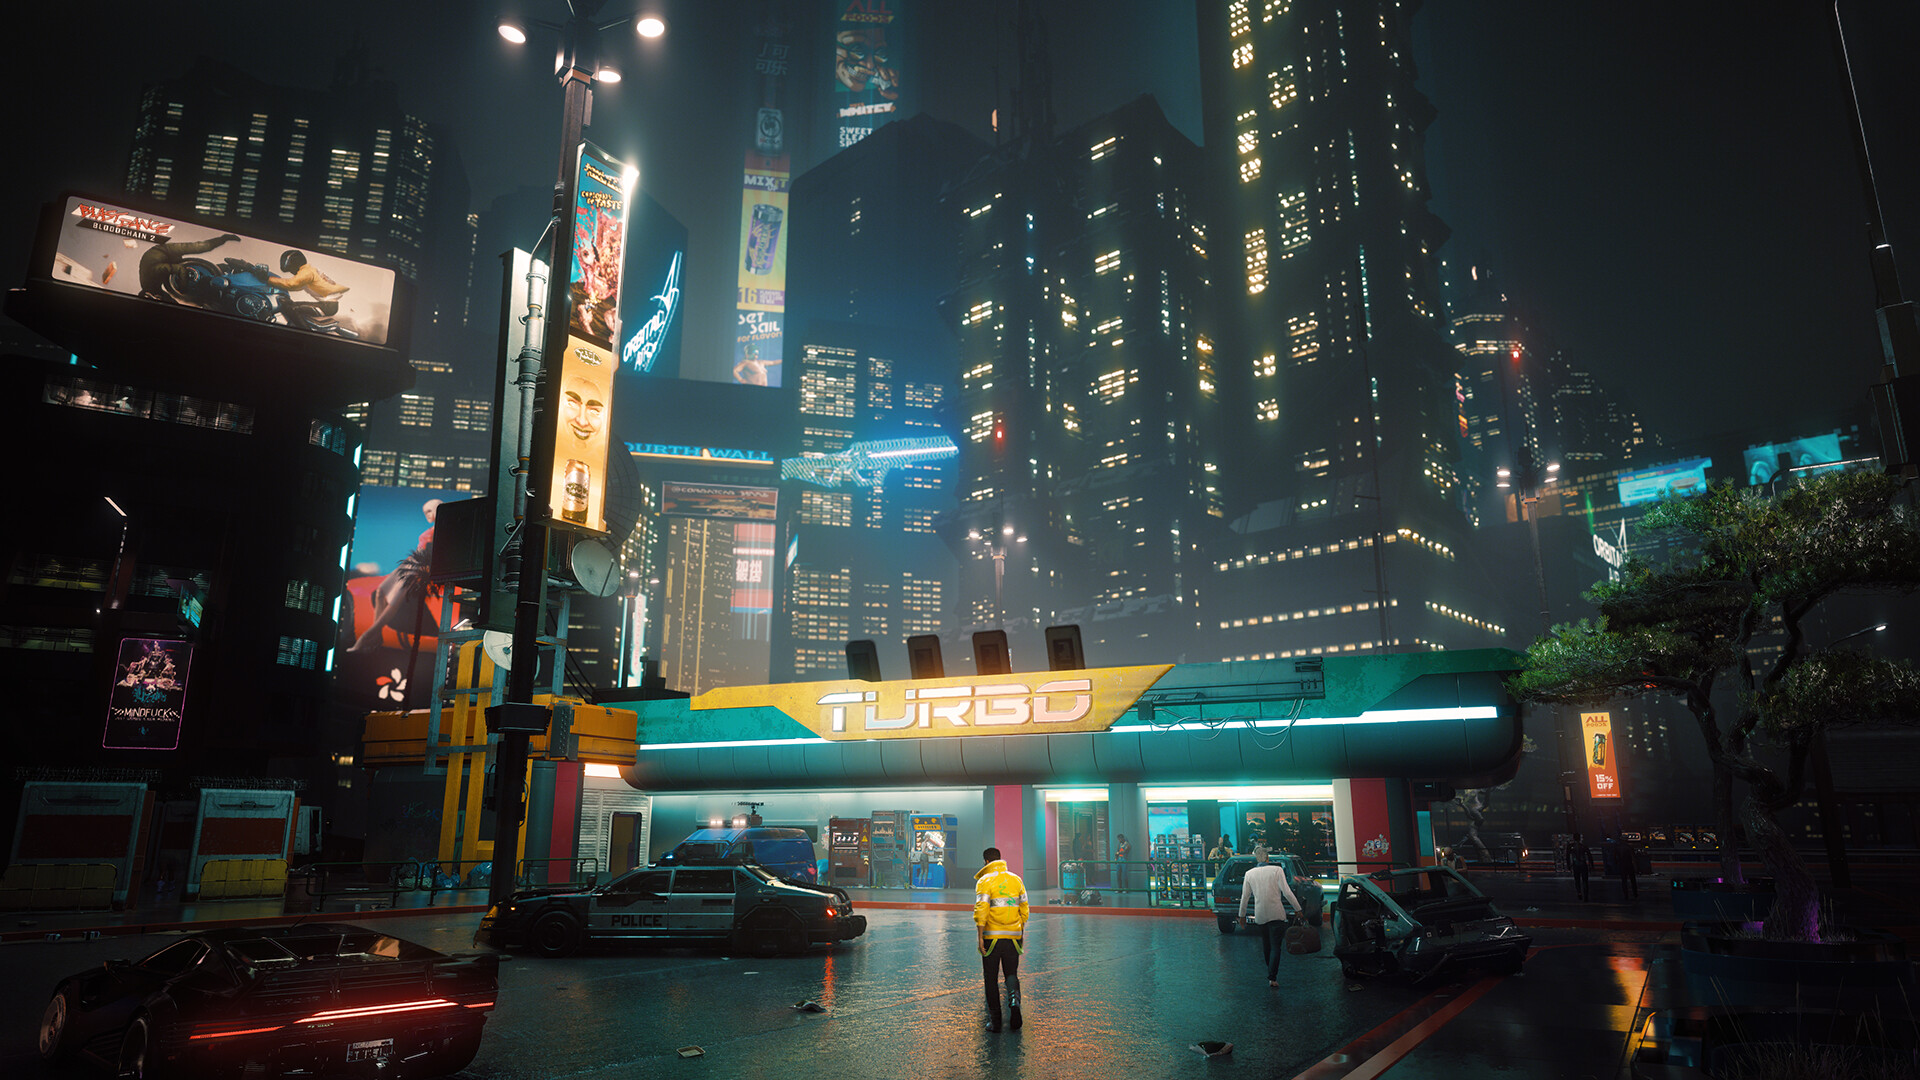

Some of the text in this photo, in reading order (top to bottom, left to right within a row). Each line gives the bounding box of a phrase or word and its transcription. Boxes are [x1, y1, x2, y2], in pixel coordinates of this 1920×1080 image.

[839, 126, 873, 135] SWEET
[839, 134, 865, 142] CLEA
[744, 175, 775, 187] MIX
[595, 198, 624, 210] TASTE
[92, 221, 156, 242] BLOODCHAIN 2
[739, 287, 758, 304] 16
[707, 447, 774, 462] WALL
[816, 678, 1092, 733] TURBO
[124, 707, 171, 718] MINDFUCK
[1595, 774, 1614, 783] 15%
[611, 914, 663, 927] POLICE
